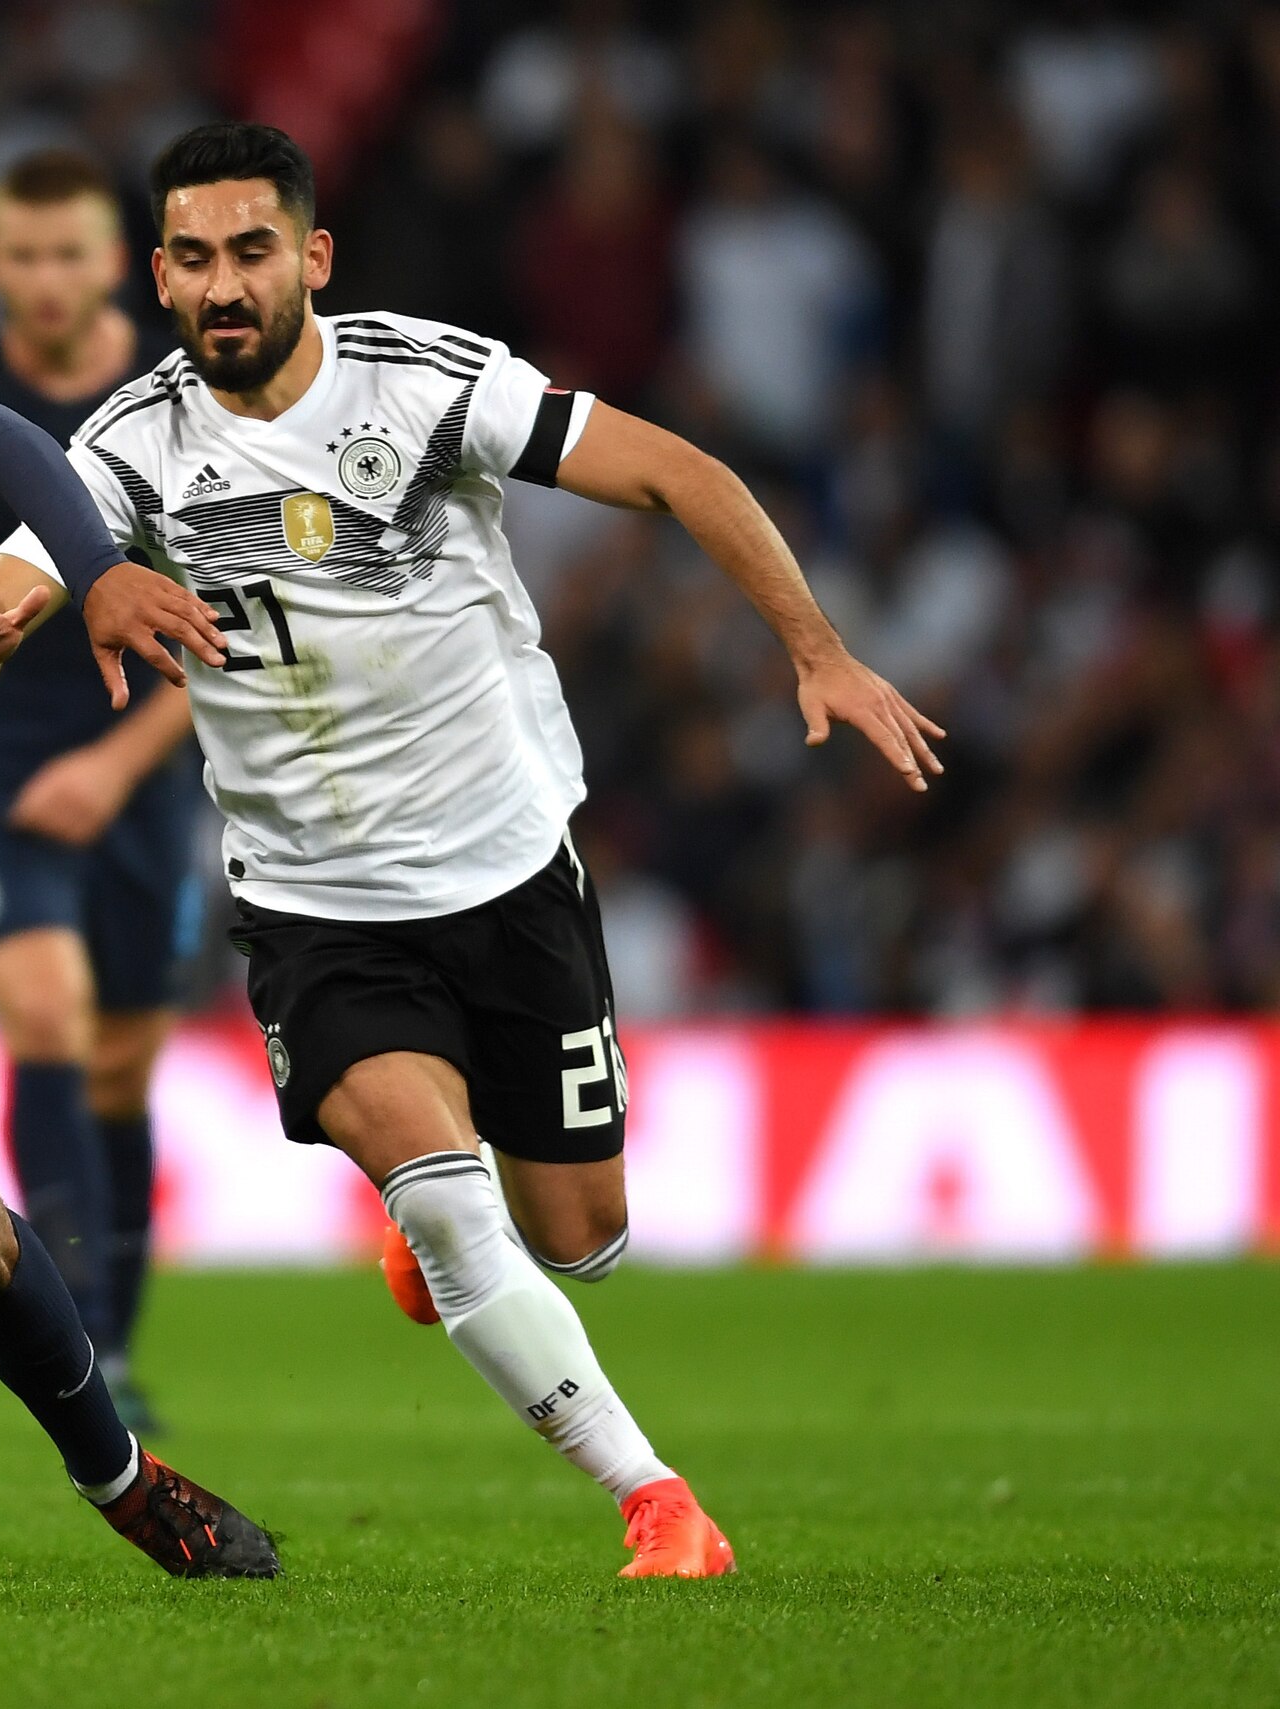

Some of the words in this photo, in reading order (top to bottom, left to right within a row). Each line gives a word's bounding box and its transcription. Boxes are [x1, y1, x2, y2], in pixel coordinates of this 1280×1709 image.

[182, 480, 231, 499] adidas
[195, 578, 300, 673] 21
[526, 1377, 580, 1421] DFB
